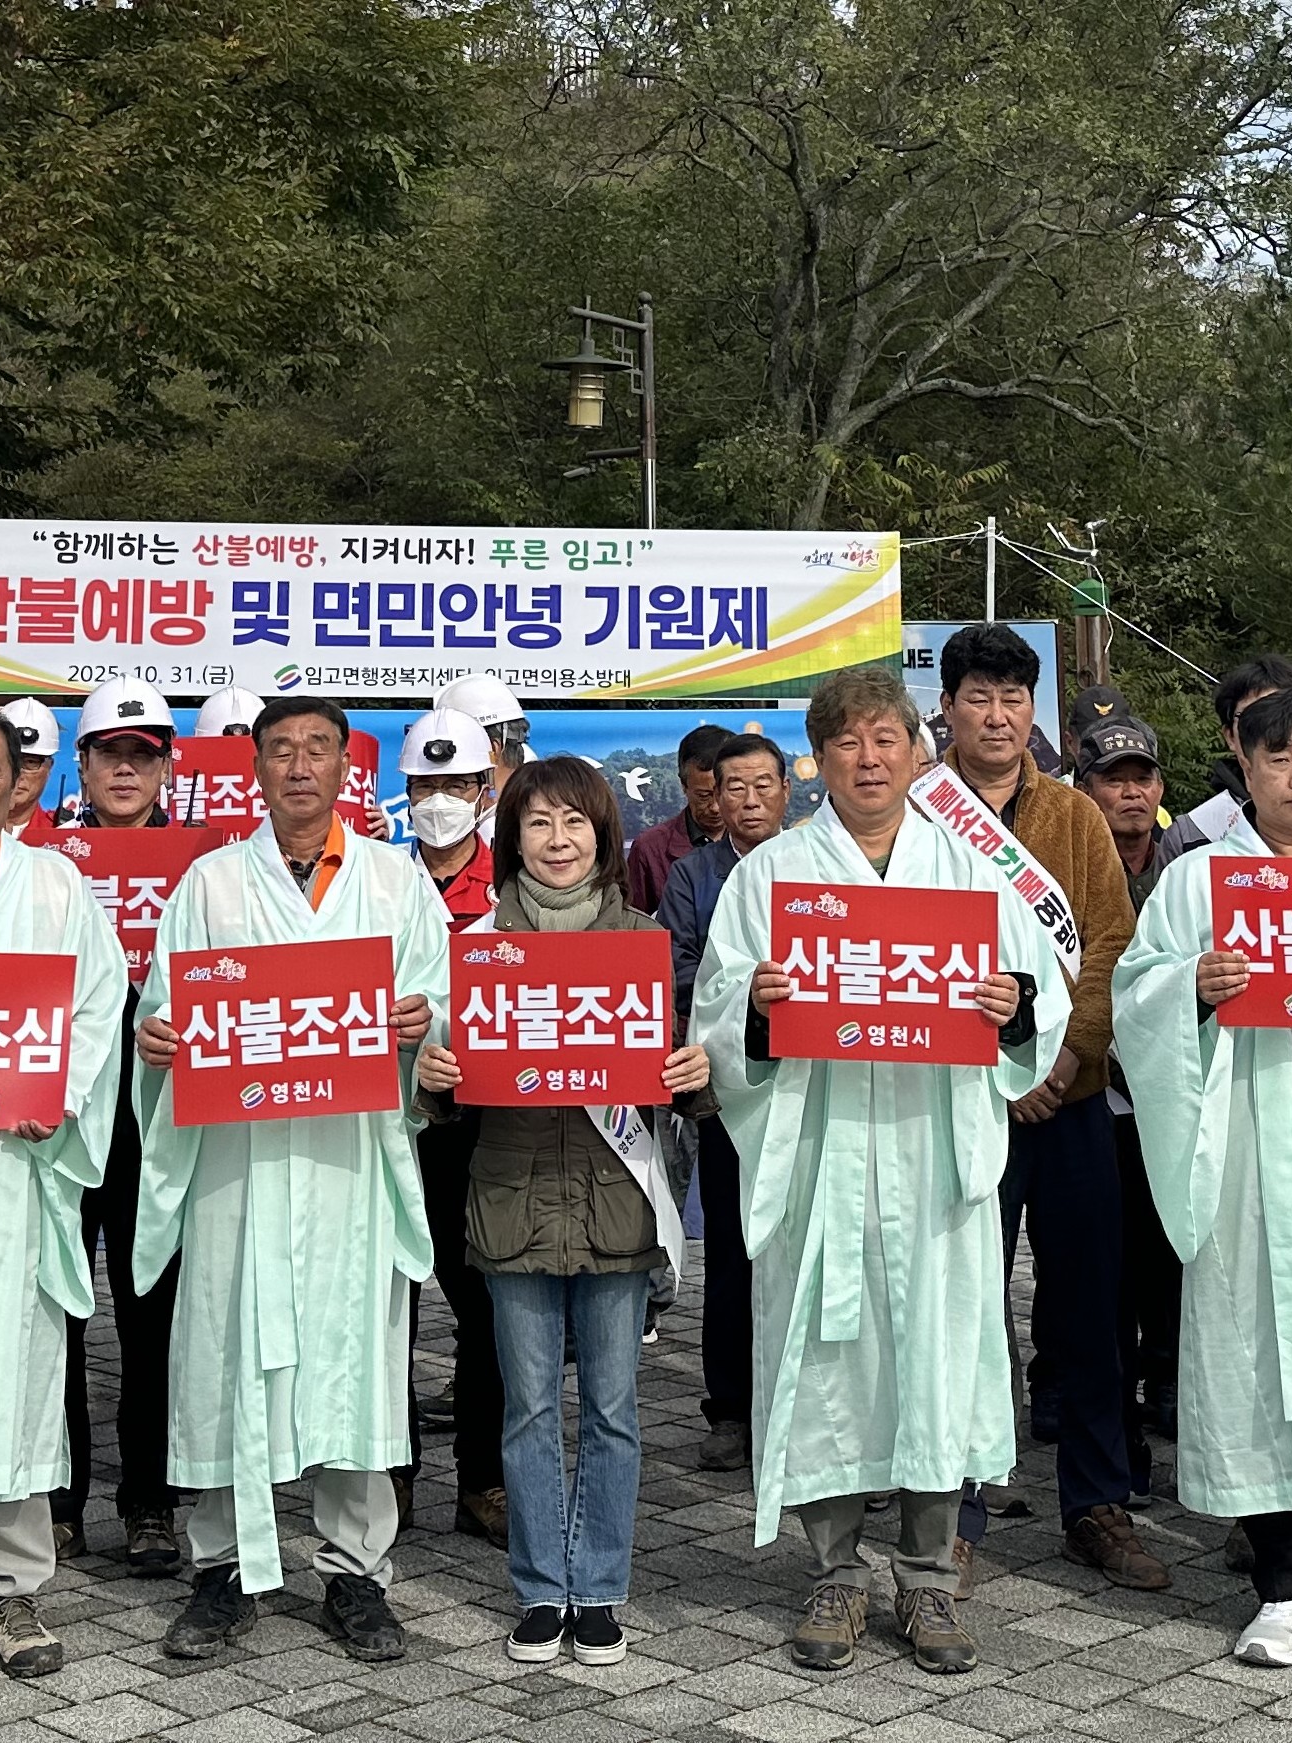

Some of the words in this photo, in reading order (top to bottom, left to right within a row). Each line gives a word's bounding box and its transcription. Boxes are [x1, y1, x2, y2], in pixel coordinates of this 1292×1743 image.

[33, 530, 179, 564] “함께하는
[192, 534, 328, 568] 산불예방,
[341, 536, 476, 567] 지켜내자!
[488, 539, 551, 570] 푸른
[562, 538, 654, 571] 임고!”
[231, 579, 291, 647] 및
[312, 580, 562, 649] 면민안녕
[584, 583, 769, 651] 기원제
[902, 648, 935, 669] 내도
[925, 778, 1005, 857] 불조심
[782, 936, 990, 1010] 산불조심
[180, 987, 390, 1070] 산불조심
[459, 981, 665, 1051] 산불조심
[867, 1025, 931, 1049] 영천시
[270, 1078, 334, 1104] 영천시
[546, 1069, 608, 1092] 영천시
[617, 1121, 644, 1155] 영천시
